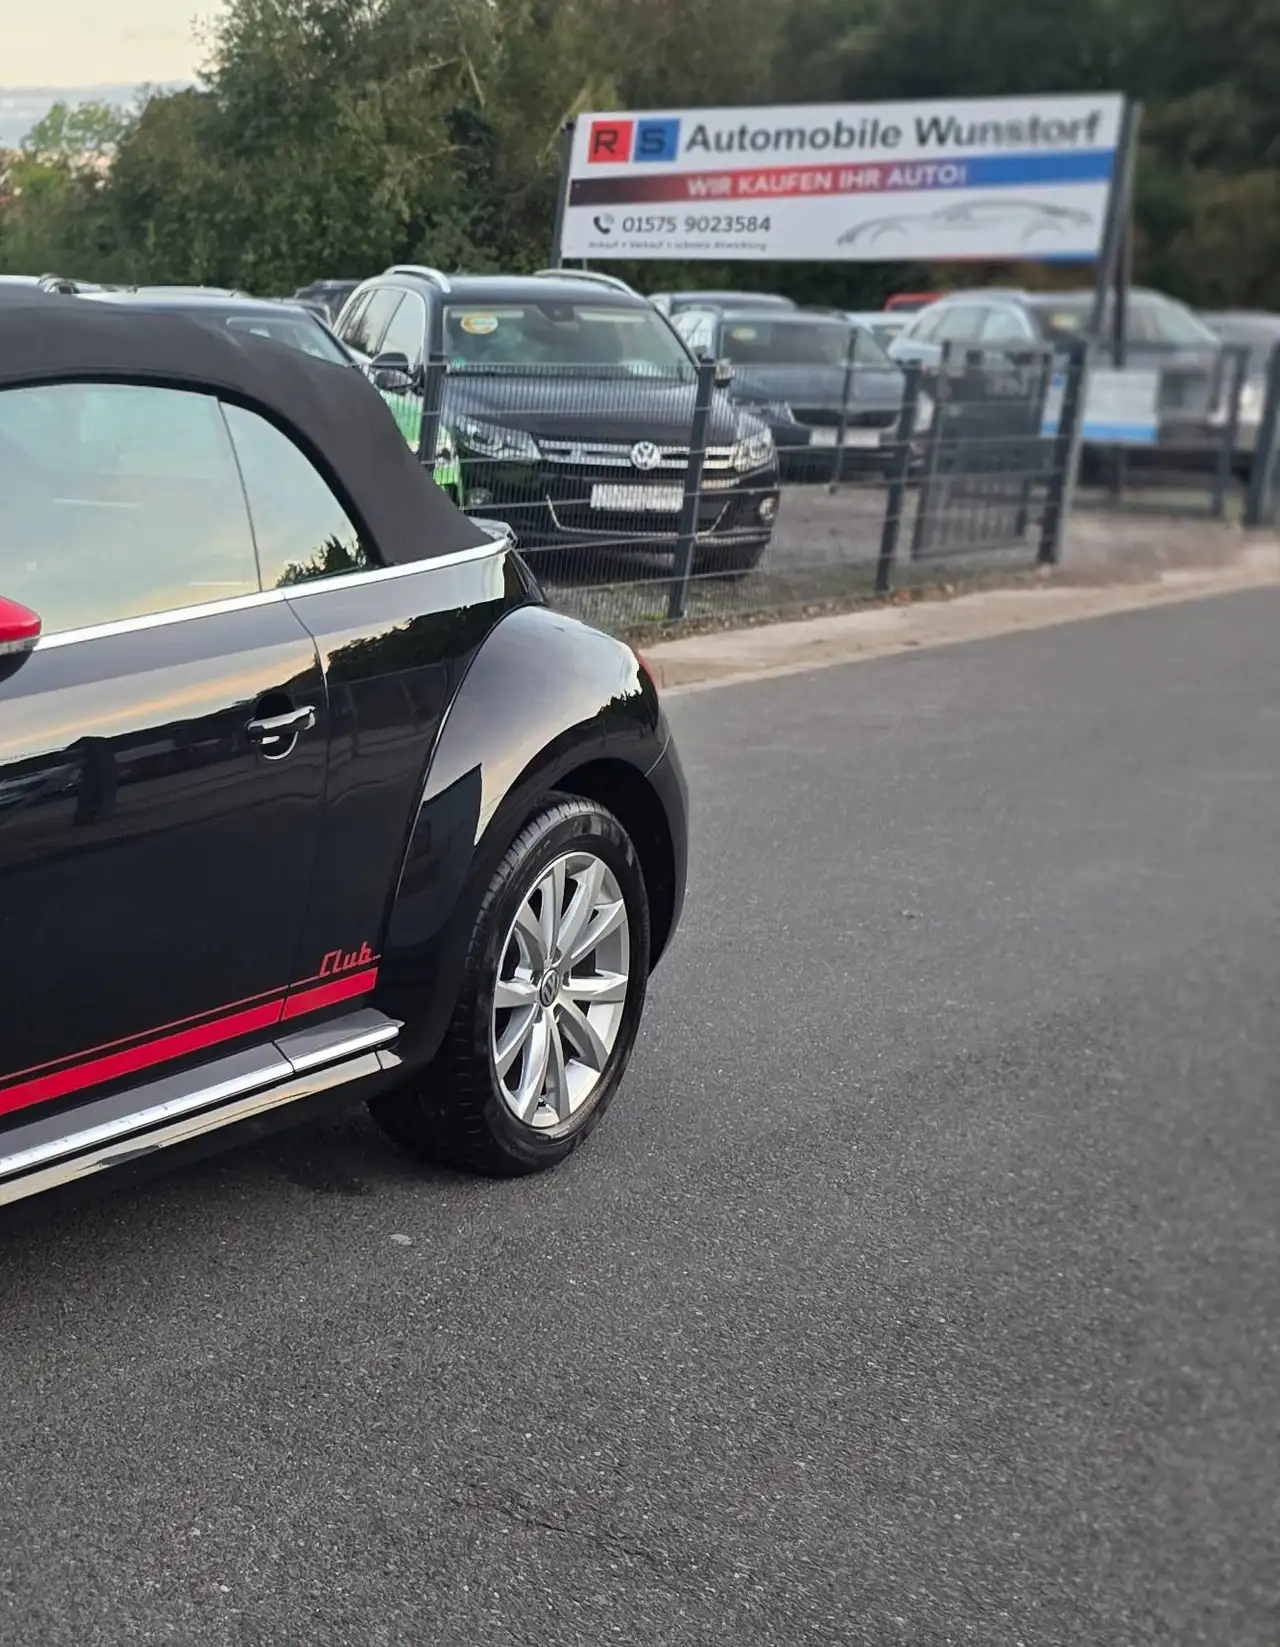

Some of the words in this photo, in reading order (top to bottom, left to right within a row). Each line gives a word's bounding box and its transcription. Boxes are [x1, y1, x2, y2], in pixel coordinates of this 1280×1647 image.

[685, 118, 902, 152] Automobile
[915, 109, 1103, 147] Wunstorf
[687, 175, 732, 196] WIR
[740, 169, 832, 194] KAUFEN
[840, 168, 881, 189] IHR
[887, 164, 967, 186] AUTO!
[622, 216, 676, 233] 01575
[684, 215, 771, 234] 9023584
[320, 941, 373, 977] Club
